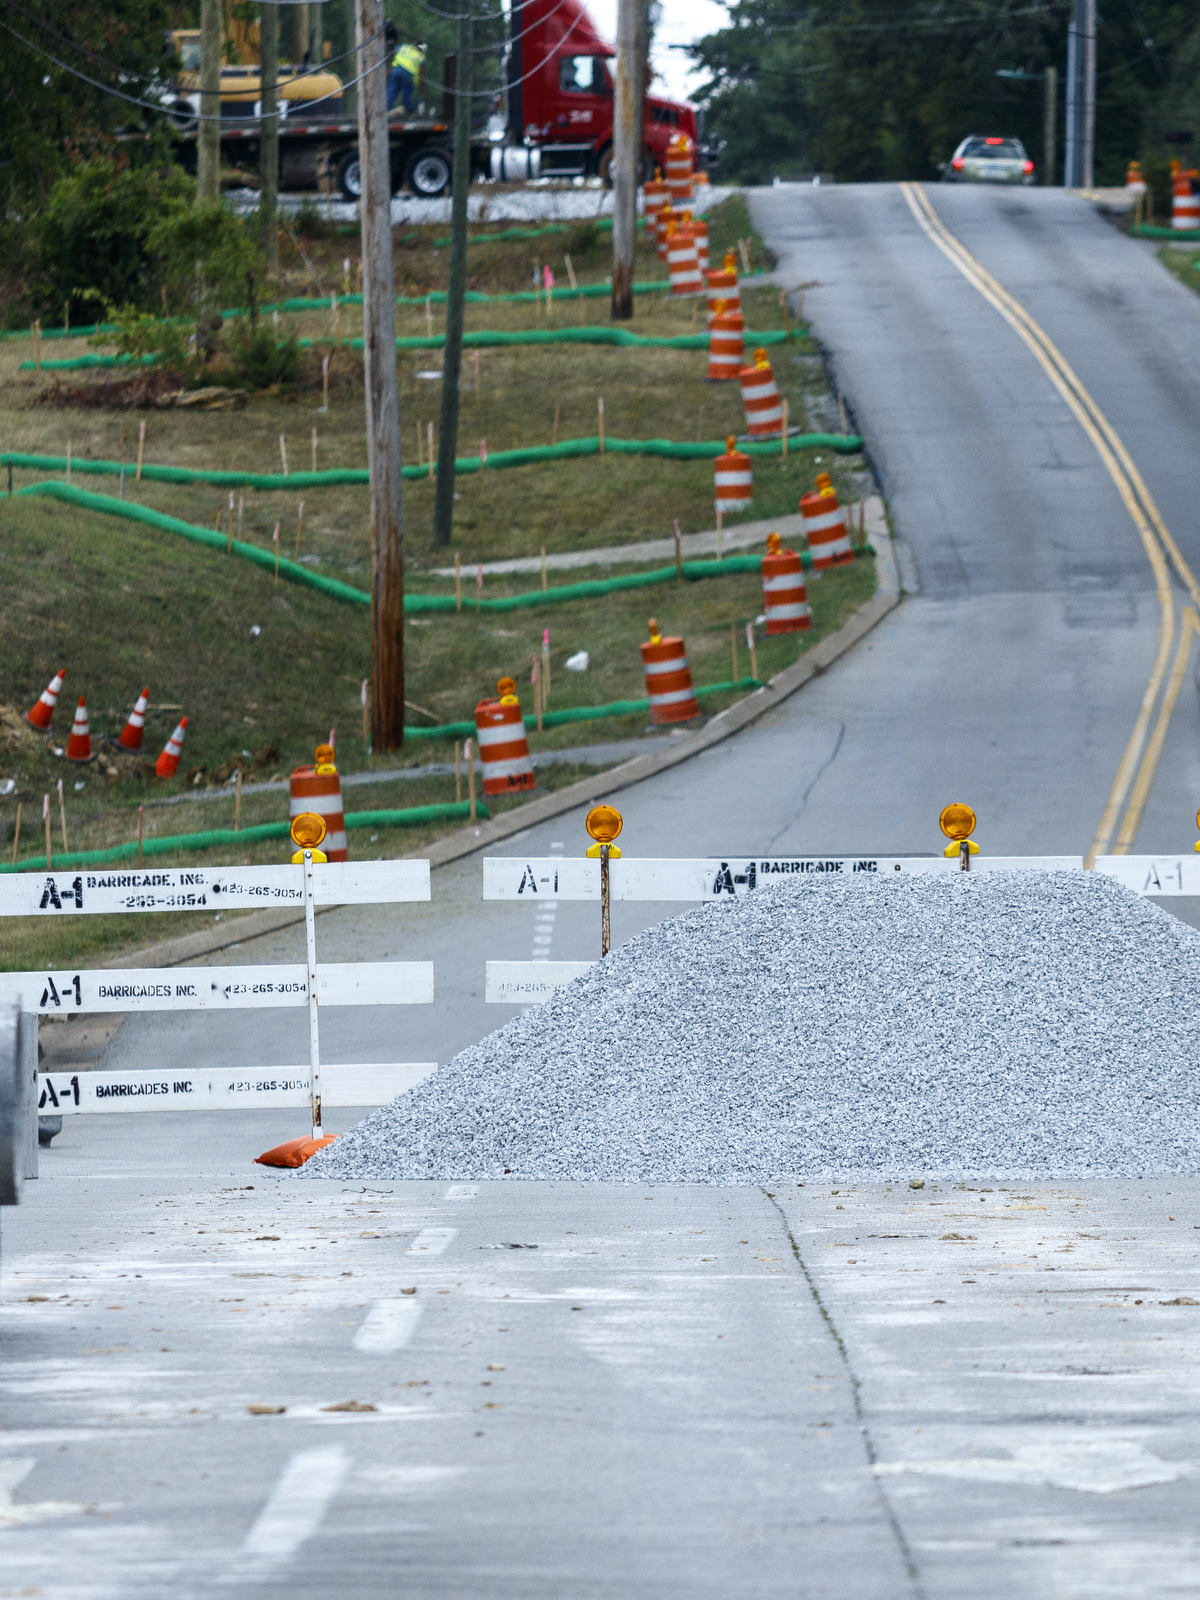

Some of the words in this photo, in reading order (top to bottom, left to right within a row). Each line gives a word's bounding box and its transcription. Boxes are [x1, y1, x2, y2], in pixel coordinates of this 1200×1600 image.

[87, 874, 175, 888] BARRICADE,
[518, 864, 559, 894] A-1
[713, 862, 757, 894] A-1
[760, 861, 845, 874] BARRICADE
[1143, 861, 1183, 891] A-1
[39, 877, 83, 909] A-1
[222, 884, 303, 899] 423-265-3054
[40, 975, 82, 1007] A-1
[98, 985, 171, 998] BARRICADES
[176, 984, 198, 997] INC.
[225, 983, 306, 994] 423-265-3054
[38, 1076, 80, 1108] A-1
[96, 1082, 169, 1098] BARRICADES
[229, 1081, 310, 1092] 423-265-3054
